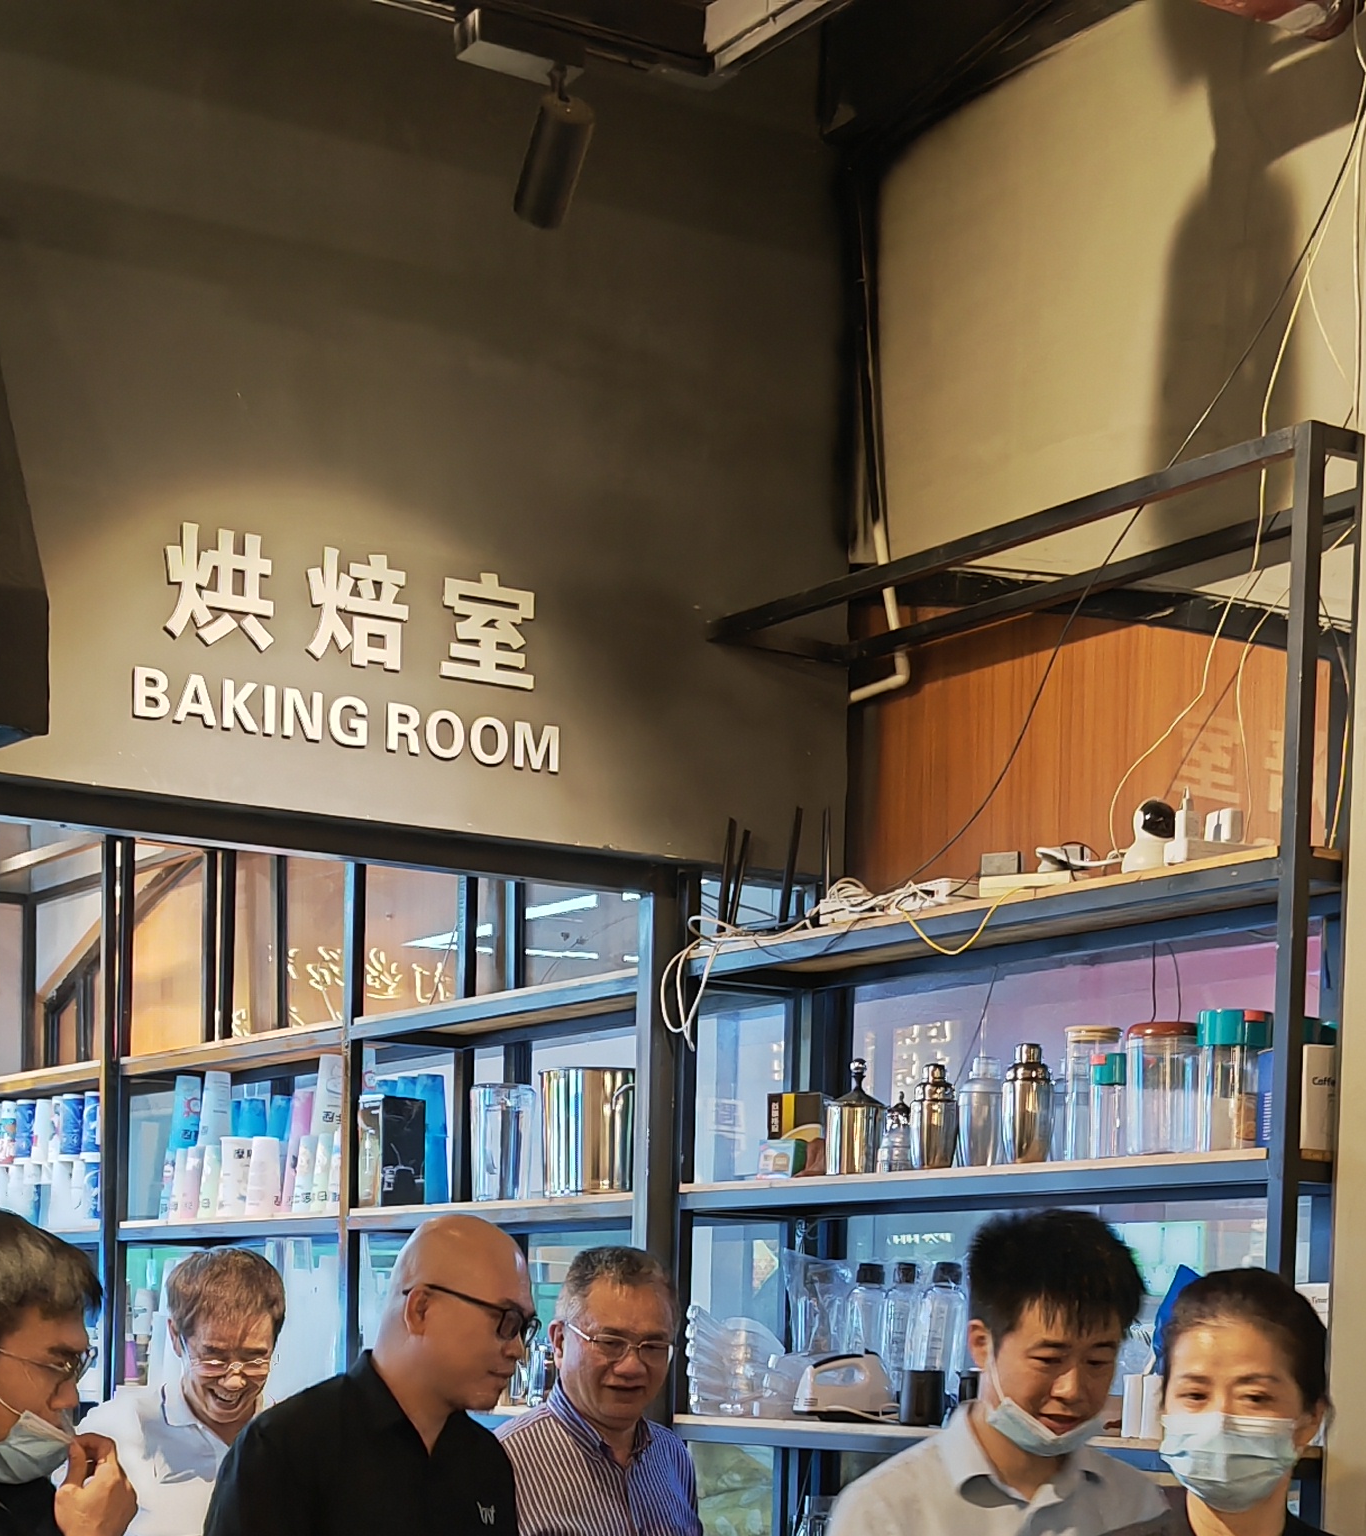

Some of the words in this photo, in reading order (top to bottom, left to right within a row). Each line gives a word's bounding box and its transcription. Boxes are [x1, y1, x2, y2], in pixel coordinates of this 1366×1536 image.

[164, 522, 536, 691] 烘焙室
[131, 666, 369, 748] BAKING
[385, 701, 561, 774] ROOM
